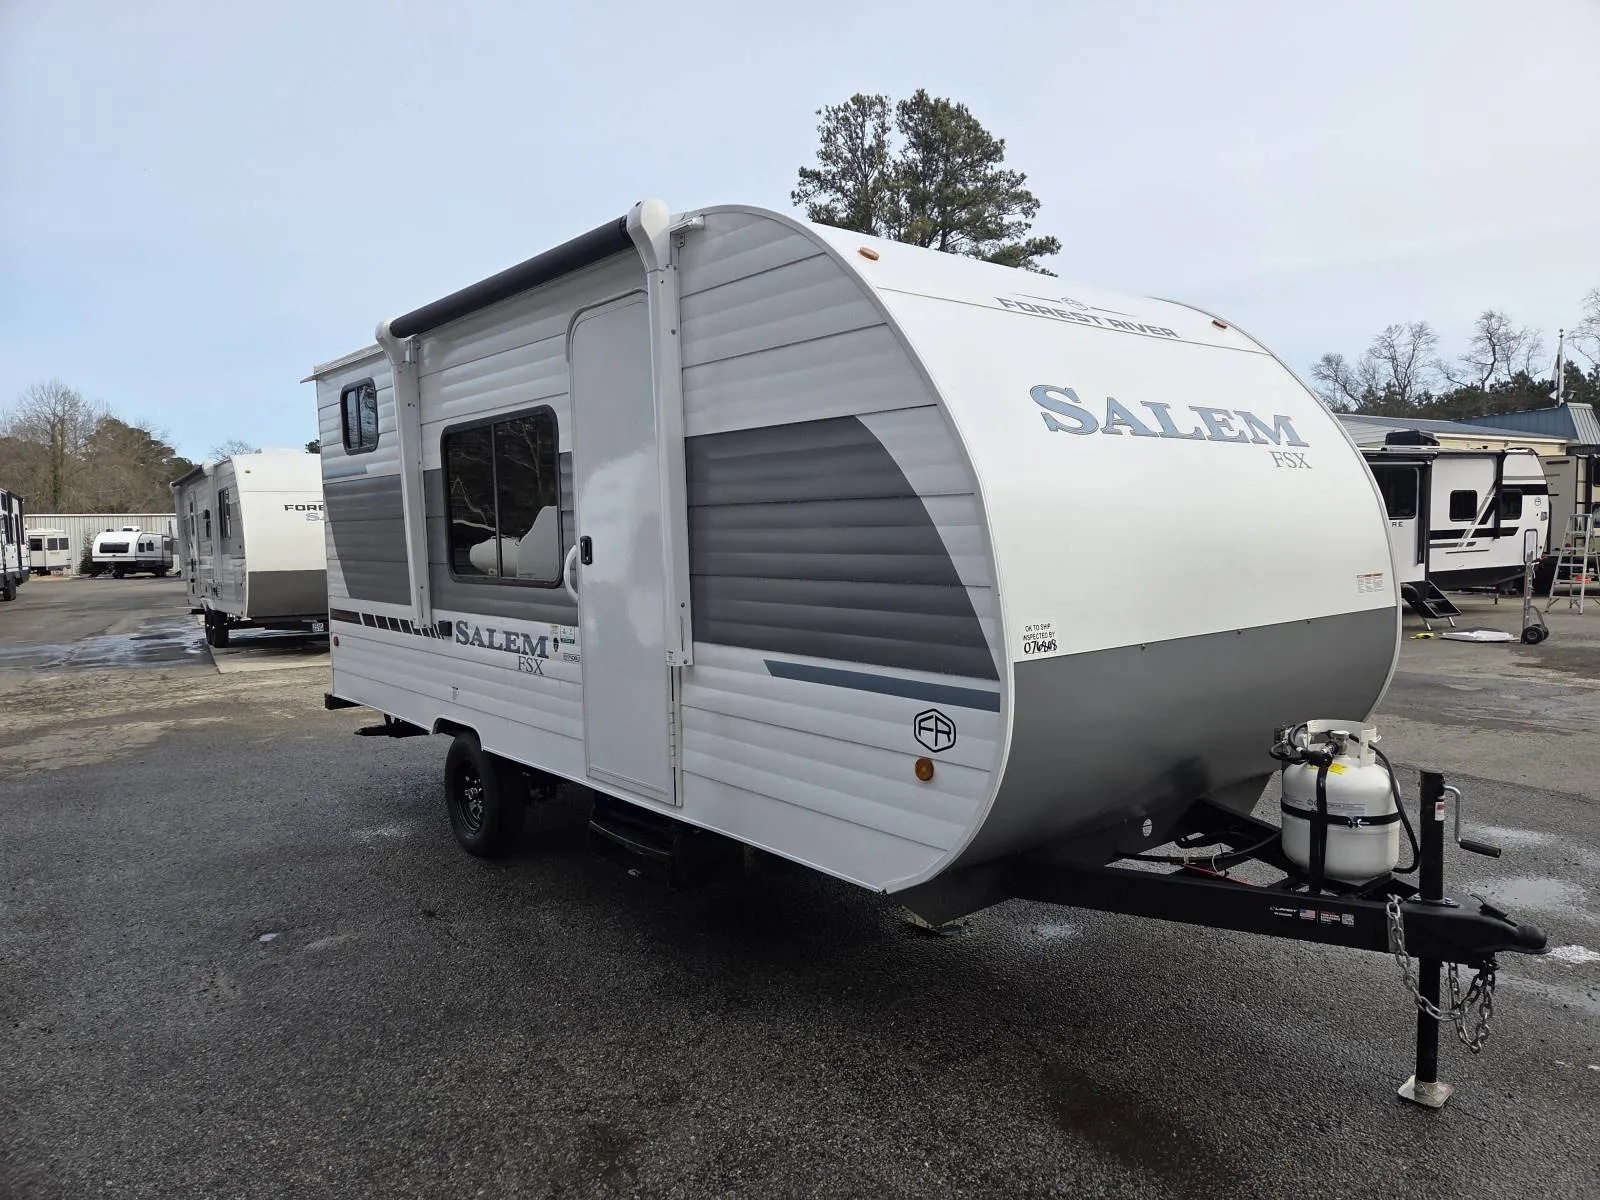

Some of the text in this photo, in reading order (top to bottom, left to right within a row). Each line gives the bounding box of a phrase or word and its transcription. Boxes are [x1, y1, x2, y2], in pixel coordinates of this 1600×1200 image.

[993, 296, 1181, 338] FOREST RIVER
[1029, 384, 1310, 447] SALEM
[1269, 450, 1312, 470] FSX
[455, 620, 550, 659] SALEM
[1048, 631, 1056, 639] BY
[518, 655, 545, 676] FSX
